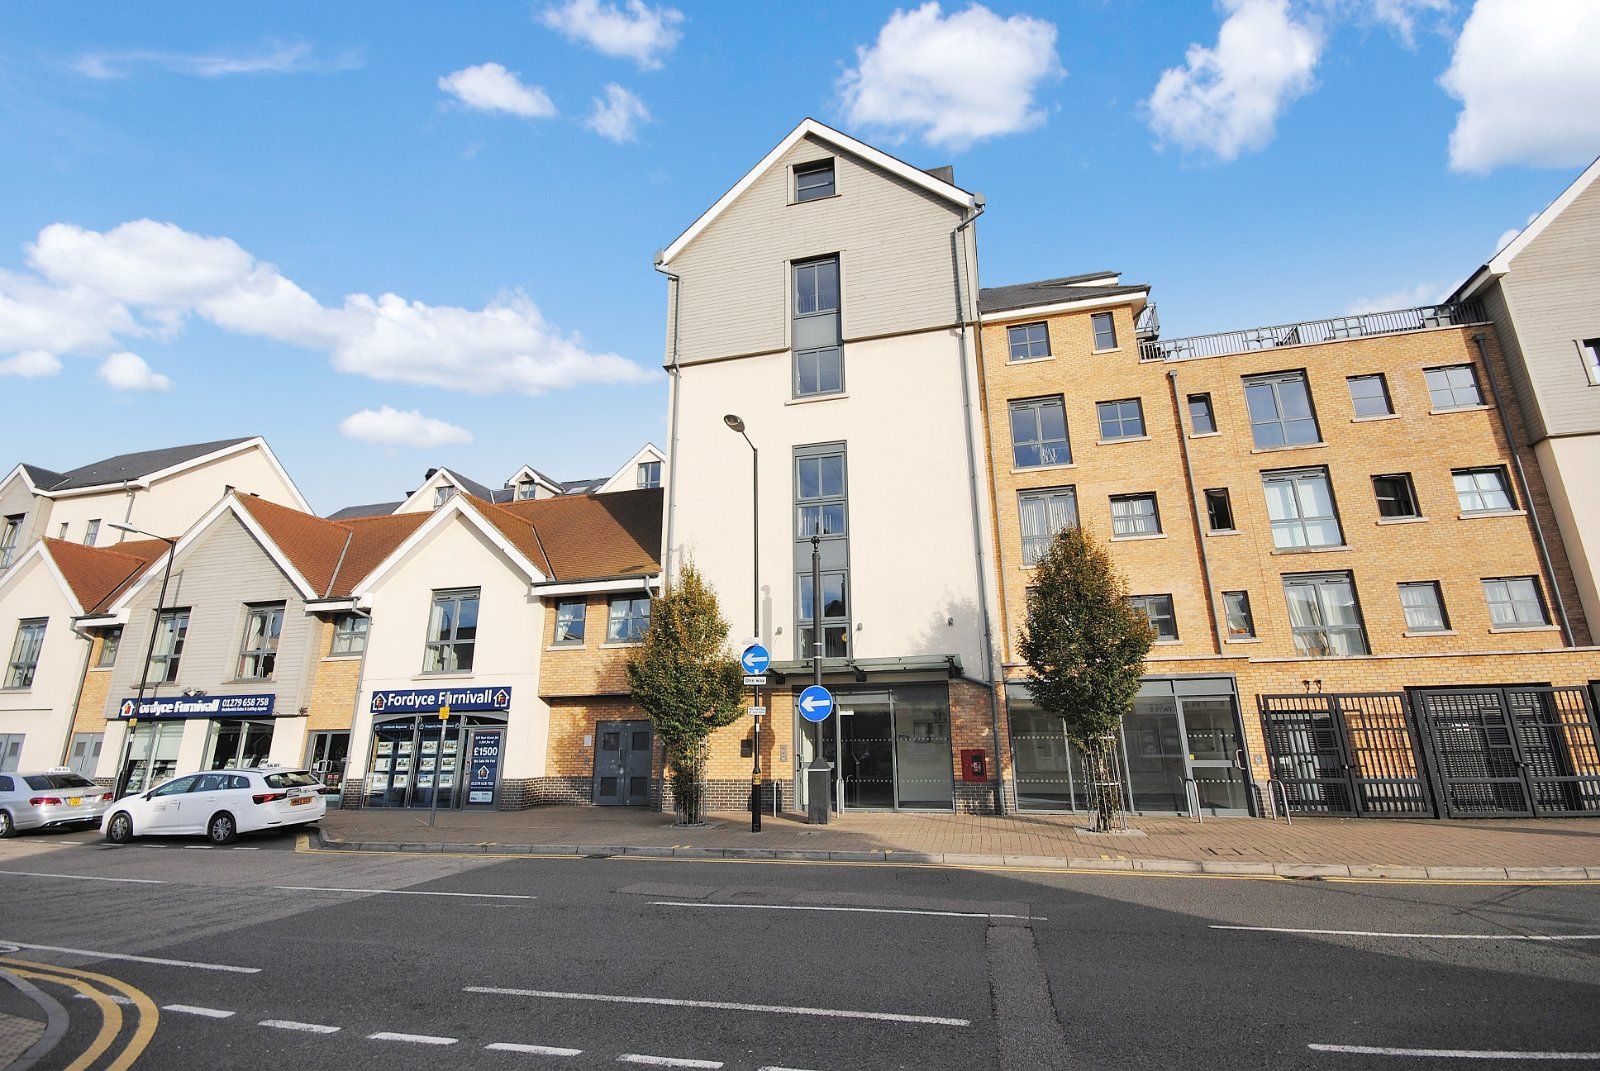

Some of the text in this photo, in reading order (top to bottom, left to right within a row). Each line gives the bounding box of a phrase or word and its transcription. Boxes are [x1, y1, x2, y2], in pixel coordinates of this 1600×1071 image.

[222, 697, 269, 707] 01279 658 758
[387, 691, 435, 708] Fordyce
[138, 698, 220, 716] ordyce Furnivall
[474, 747, 498, 756] £1500
